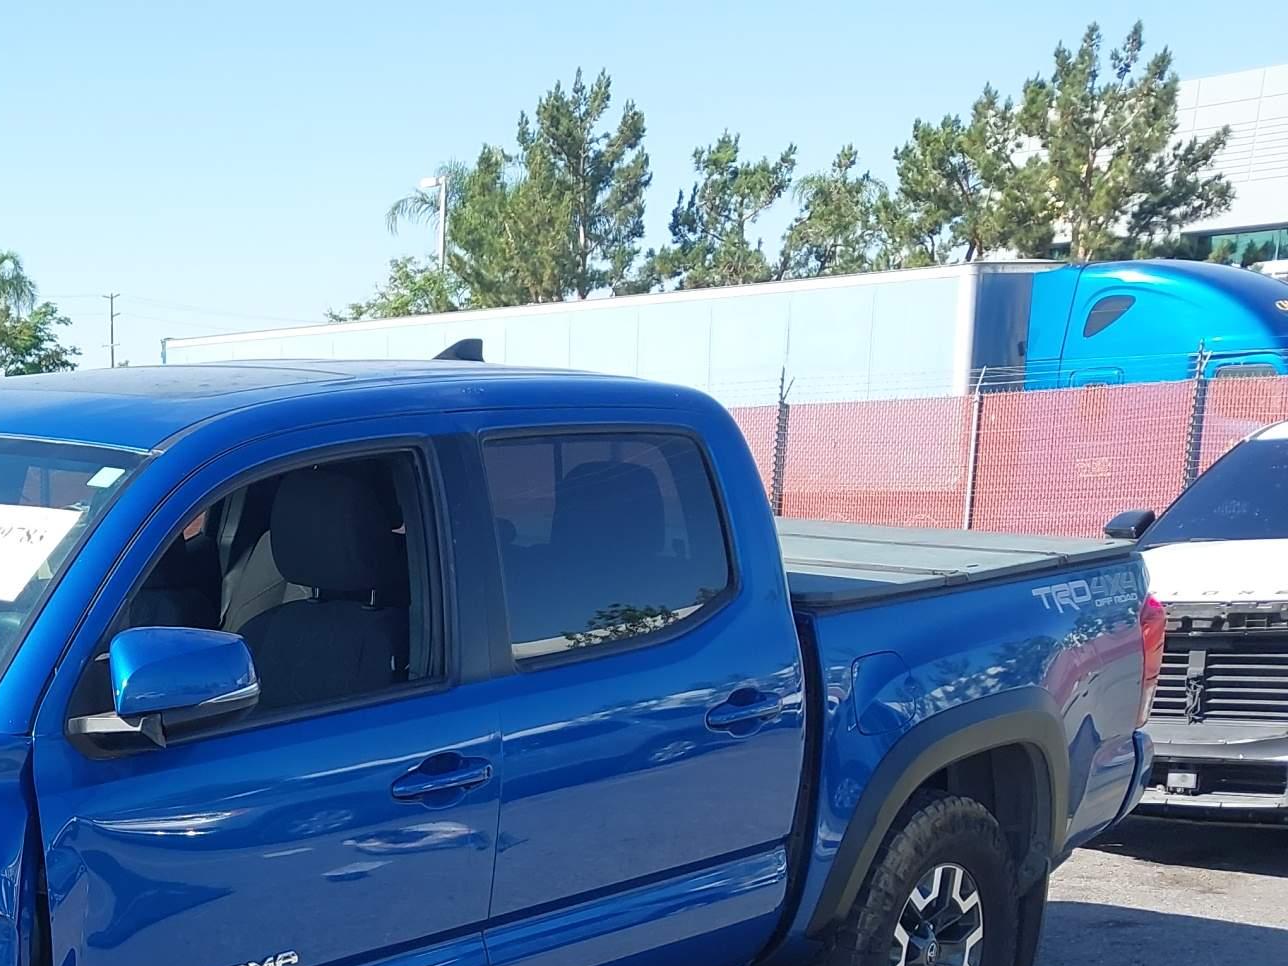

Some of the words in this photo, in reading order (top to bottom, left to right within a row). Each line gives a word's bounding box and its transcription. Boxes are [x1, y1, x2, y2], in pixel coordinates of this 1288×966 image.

[1031, 578, 1092, 614] TRD
[1095, 596, 1113, 608] OFF
[1114, 592, 1138, 604] ROAD
